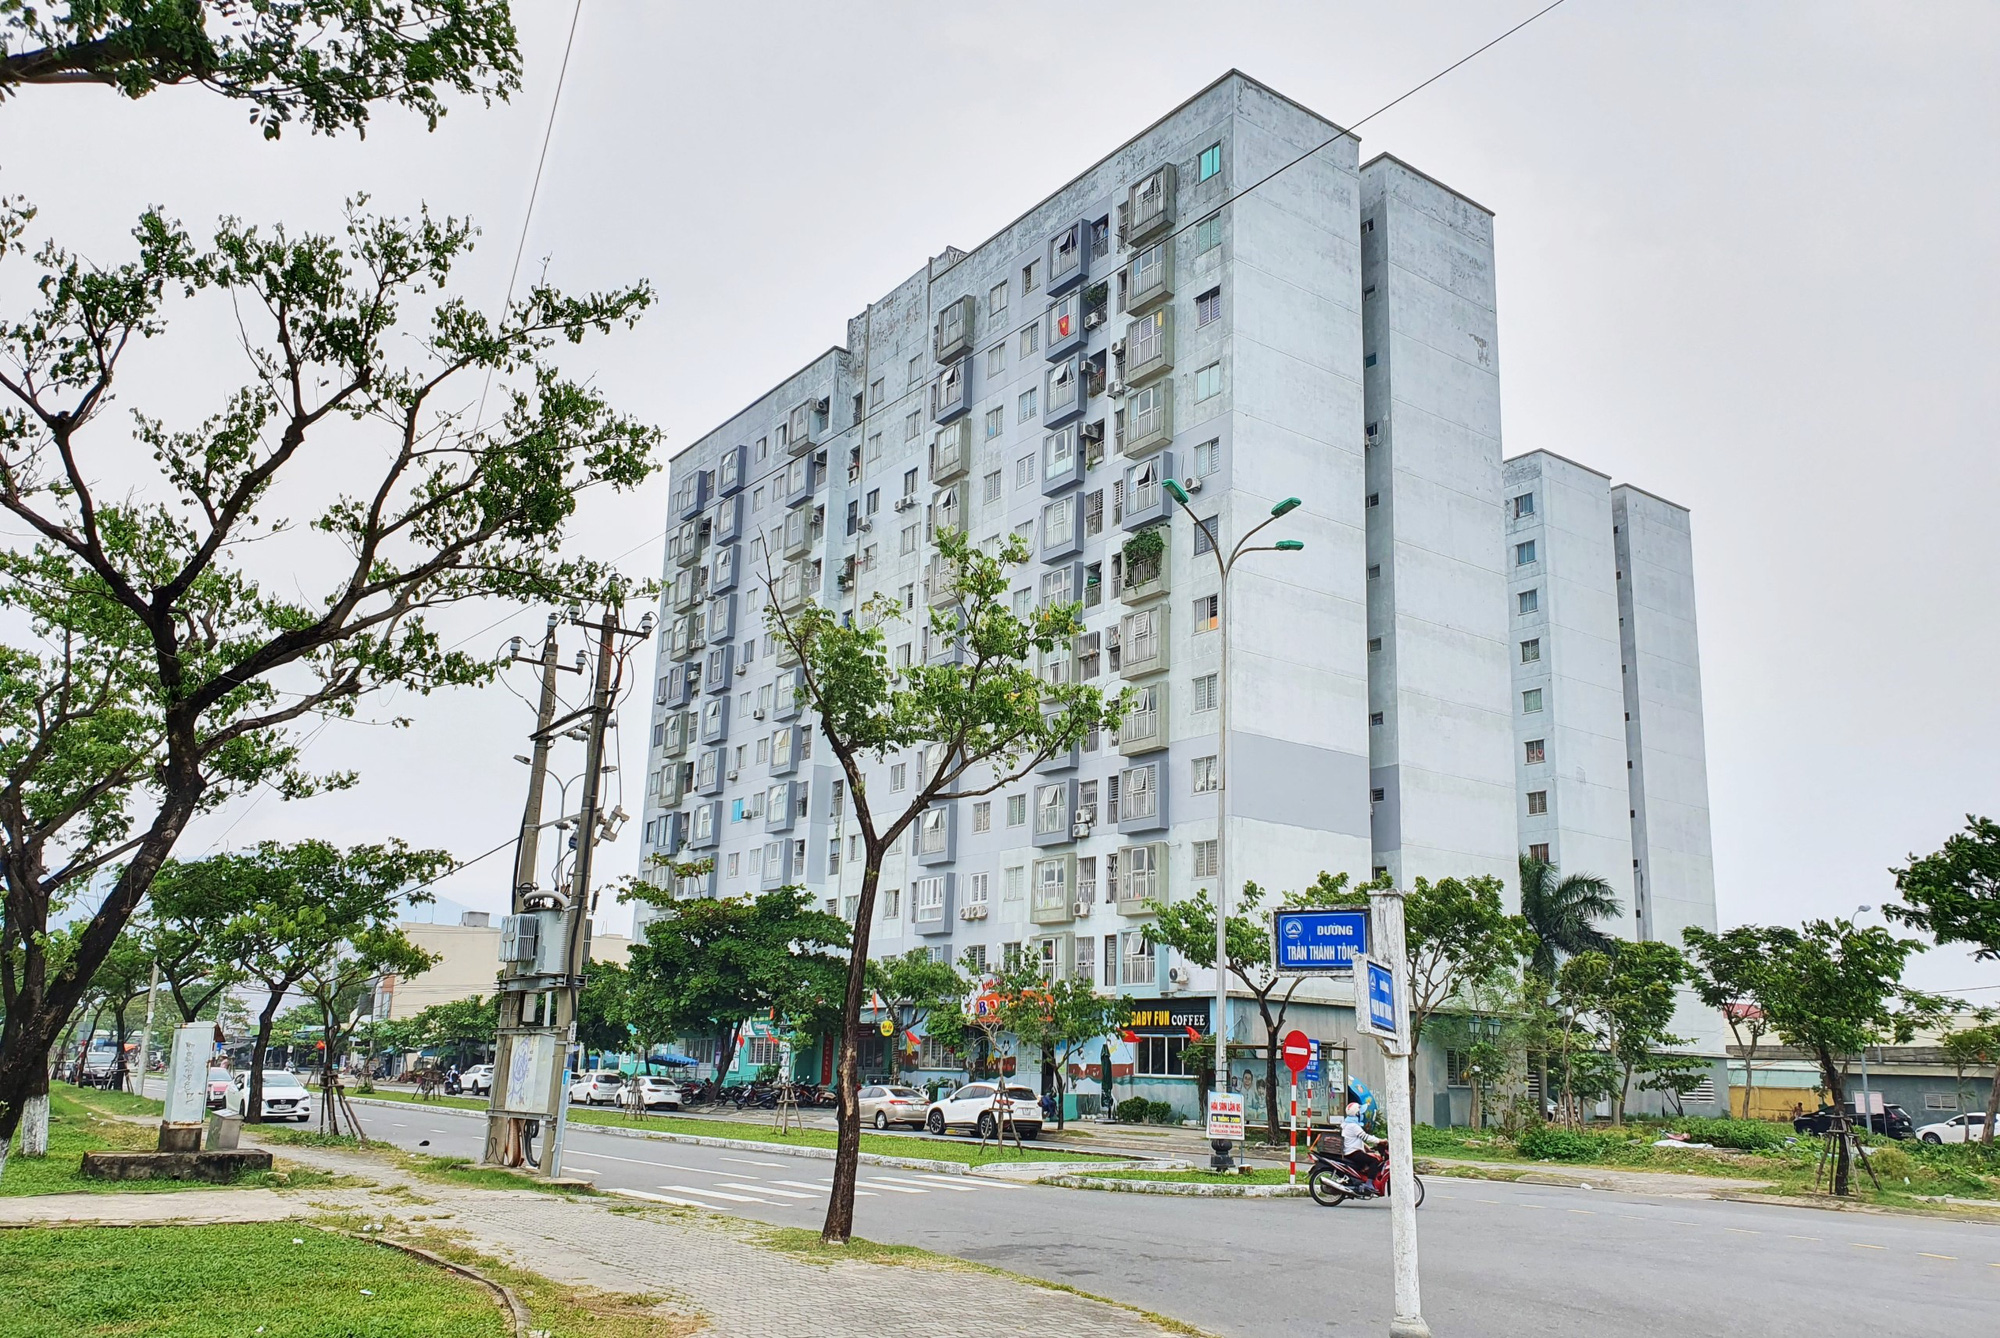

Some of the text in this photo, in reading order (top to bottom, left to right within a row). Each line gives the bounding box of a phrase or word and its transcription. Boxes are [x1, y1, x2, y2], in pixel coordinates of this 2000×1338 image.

[1317, 922, 1353, 935] ĐƯỜNG
[1287, 940, 1307, 960] TRẦN
[1131, 1010, 1205, 1026] BABY FUN COFFEE
